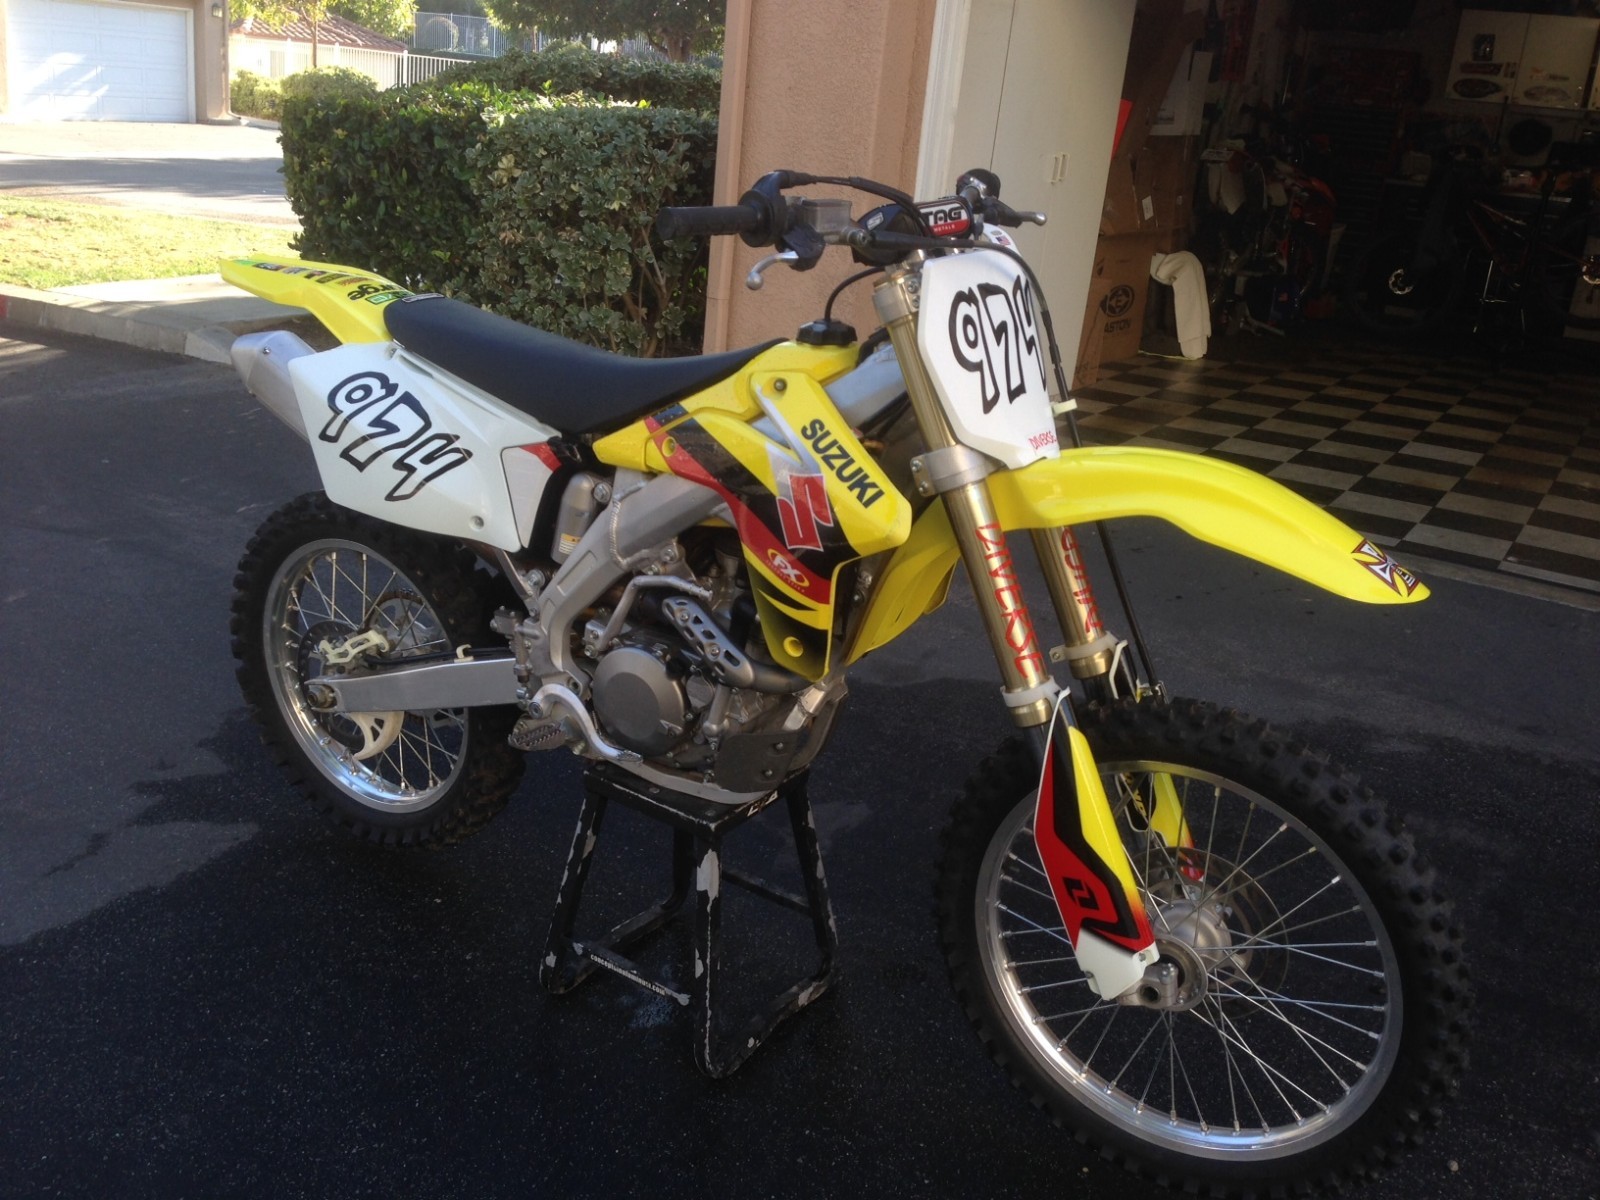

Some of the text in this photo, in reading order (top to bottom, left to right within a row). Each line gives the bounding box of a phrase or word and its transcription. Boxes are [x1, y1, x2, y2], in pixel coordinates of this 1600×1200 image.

[920, 206, 962, 224] TAG
[949, 274, 1047, 415] 974
[1104, 319, 1130, 333] ASTON
[319, 371, 473, 502] 974
[801, 418, 885, 509] SUZUKI
